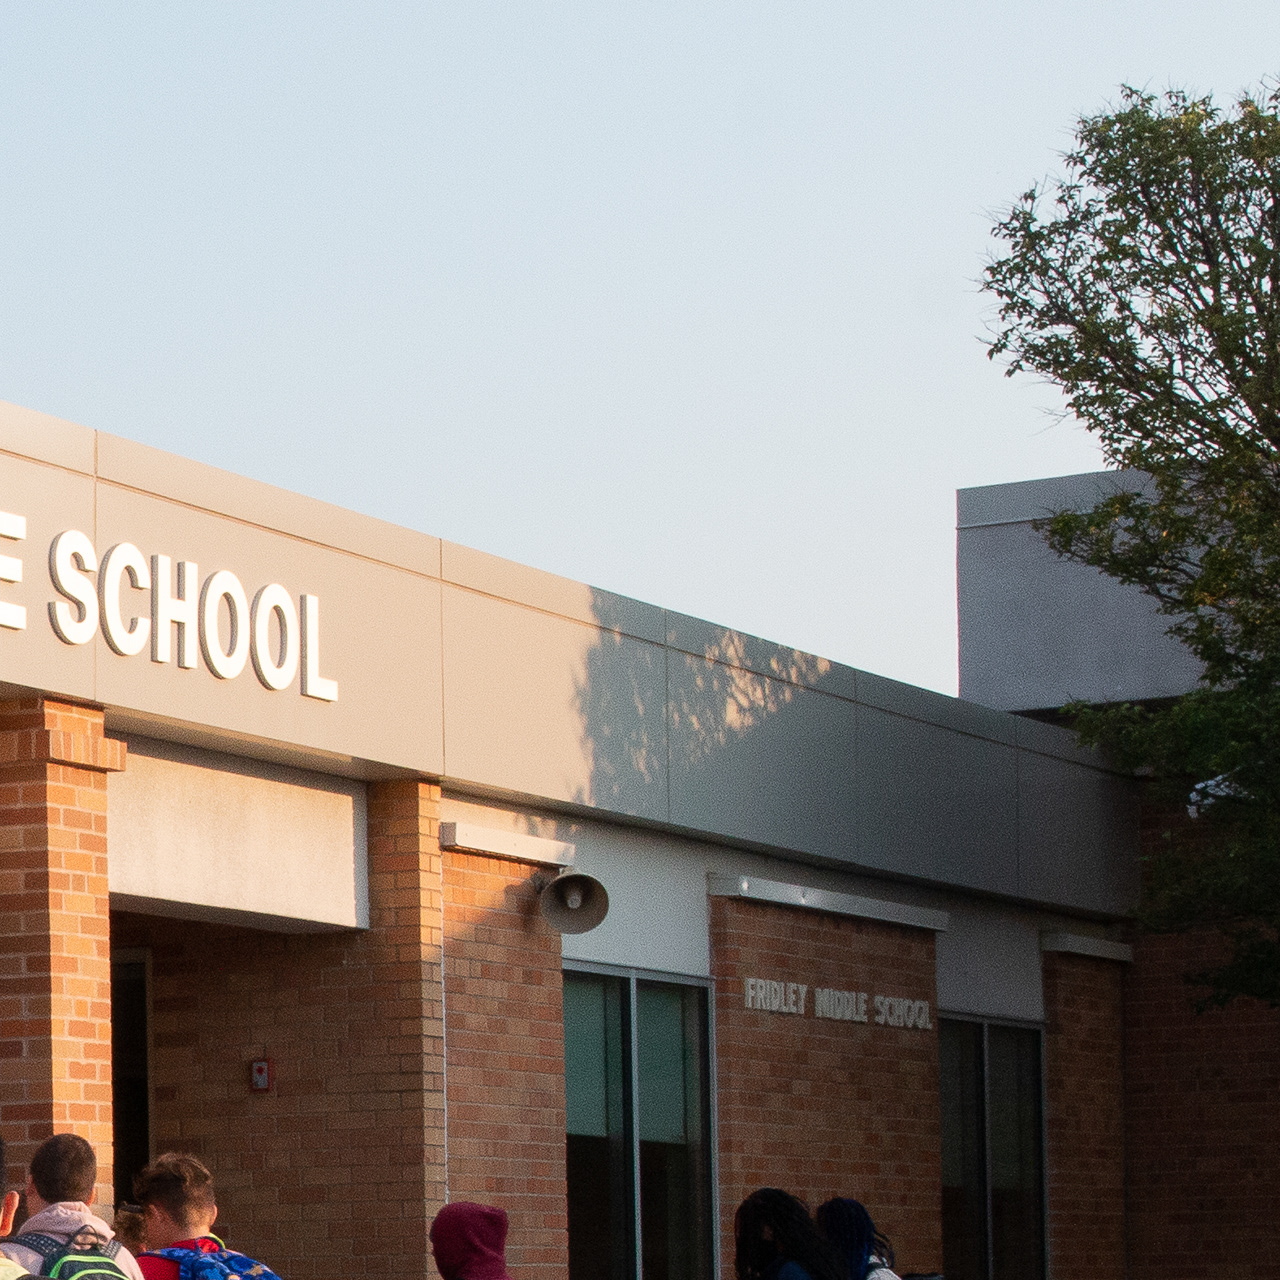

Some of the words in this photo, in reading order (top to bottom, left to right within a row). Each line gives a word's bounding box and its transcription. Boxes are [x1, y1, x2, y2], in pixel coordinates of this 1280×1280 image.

[47, 529, 339, 703] SCHOOL
[745, 977, 807, 1014] FRIDLEY
[814, 987, 868, 1022] MIDDLE
[874, 994, 933, 1030] SCHOOL
